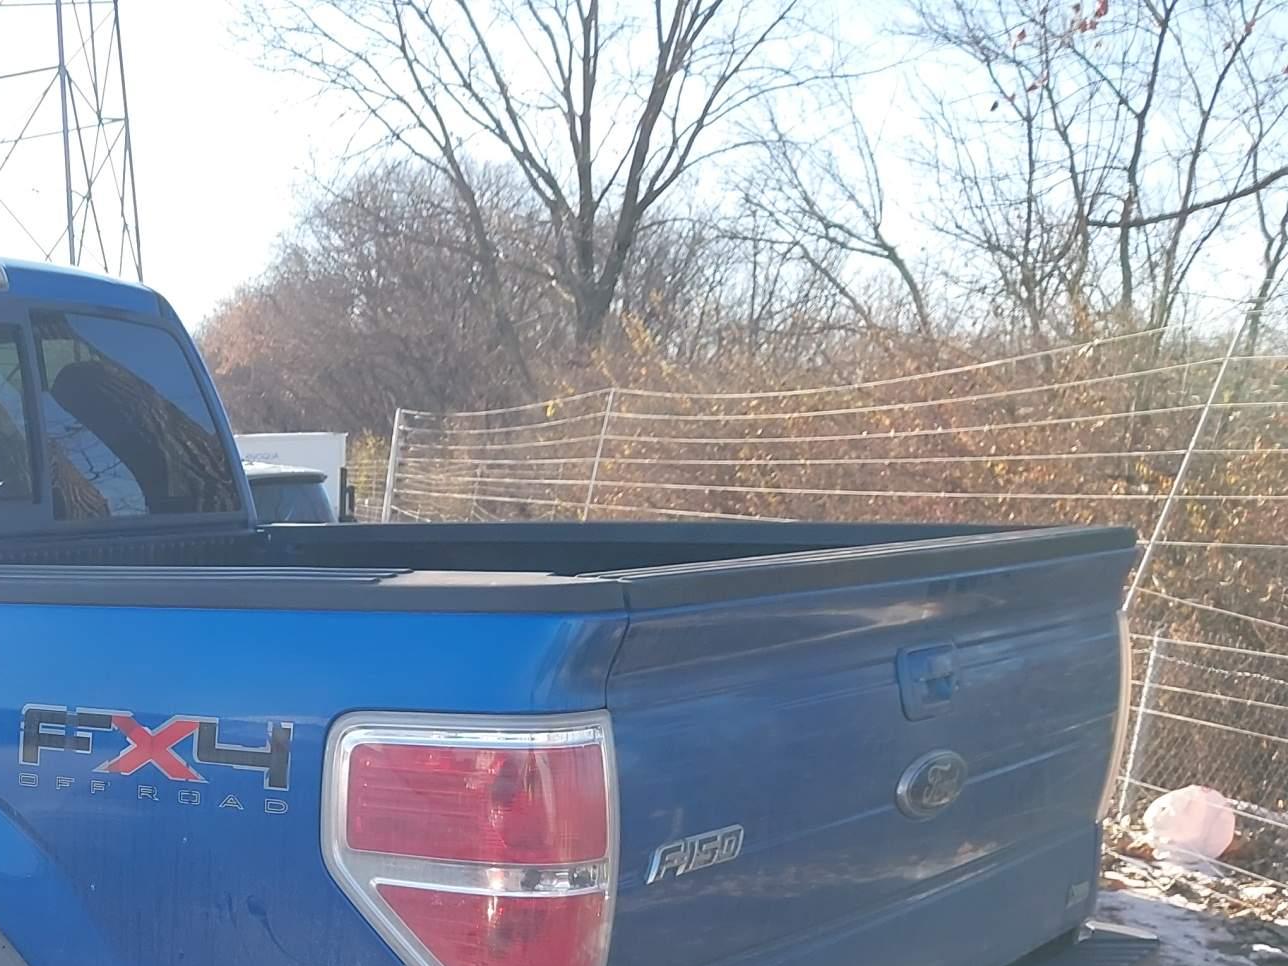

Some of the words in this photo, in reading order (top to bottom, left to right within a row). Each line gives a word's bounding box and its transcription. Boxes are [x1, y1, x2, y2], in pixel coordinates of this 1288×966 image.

[19, 703, 293, 791] FX4
[18, 773, 110, 794] OFF
[137, 784, 289, 815] ROAD
